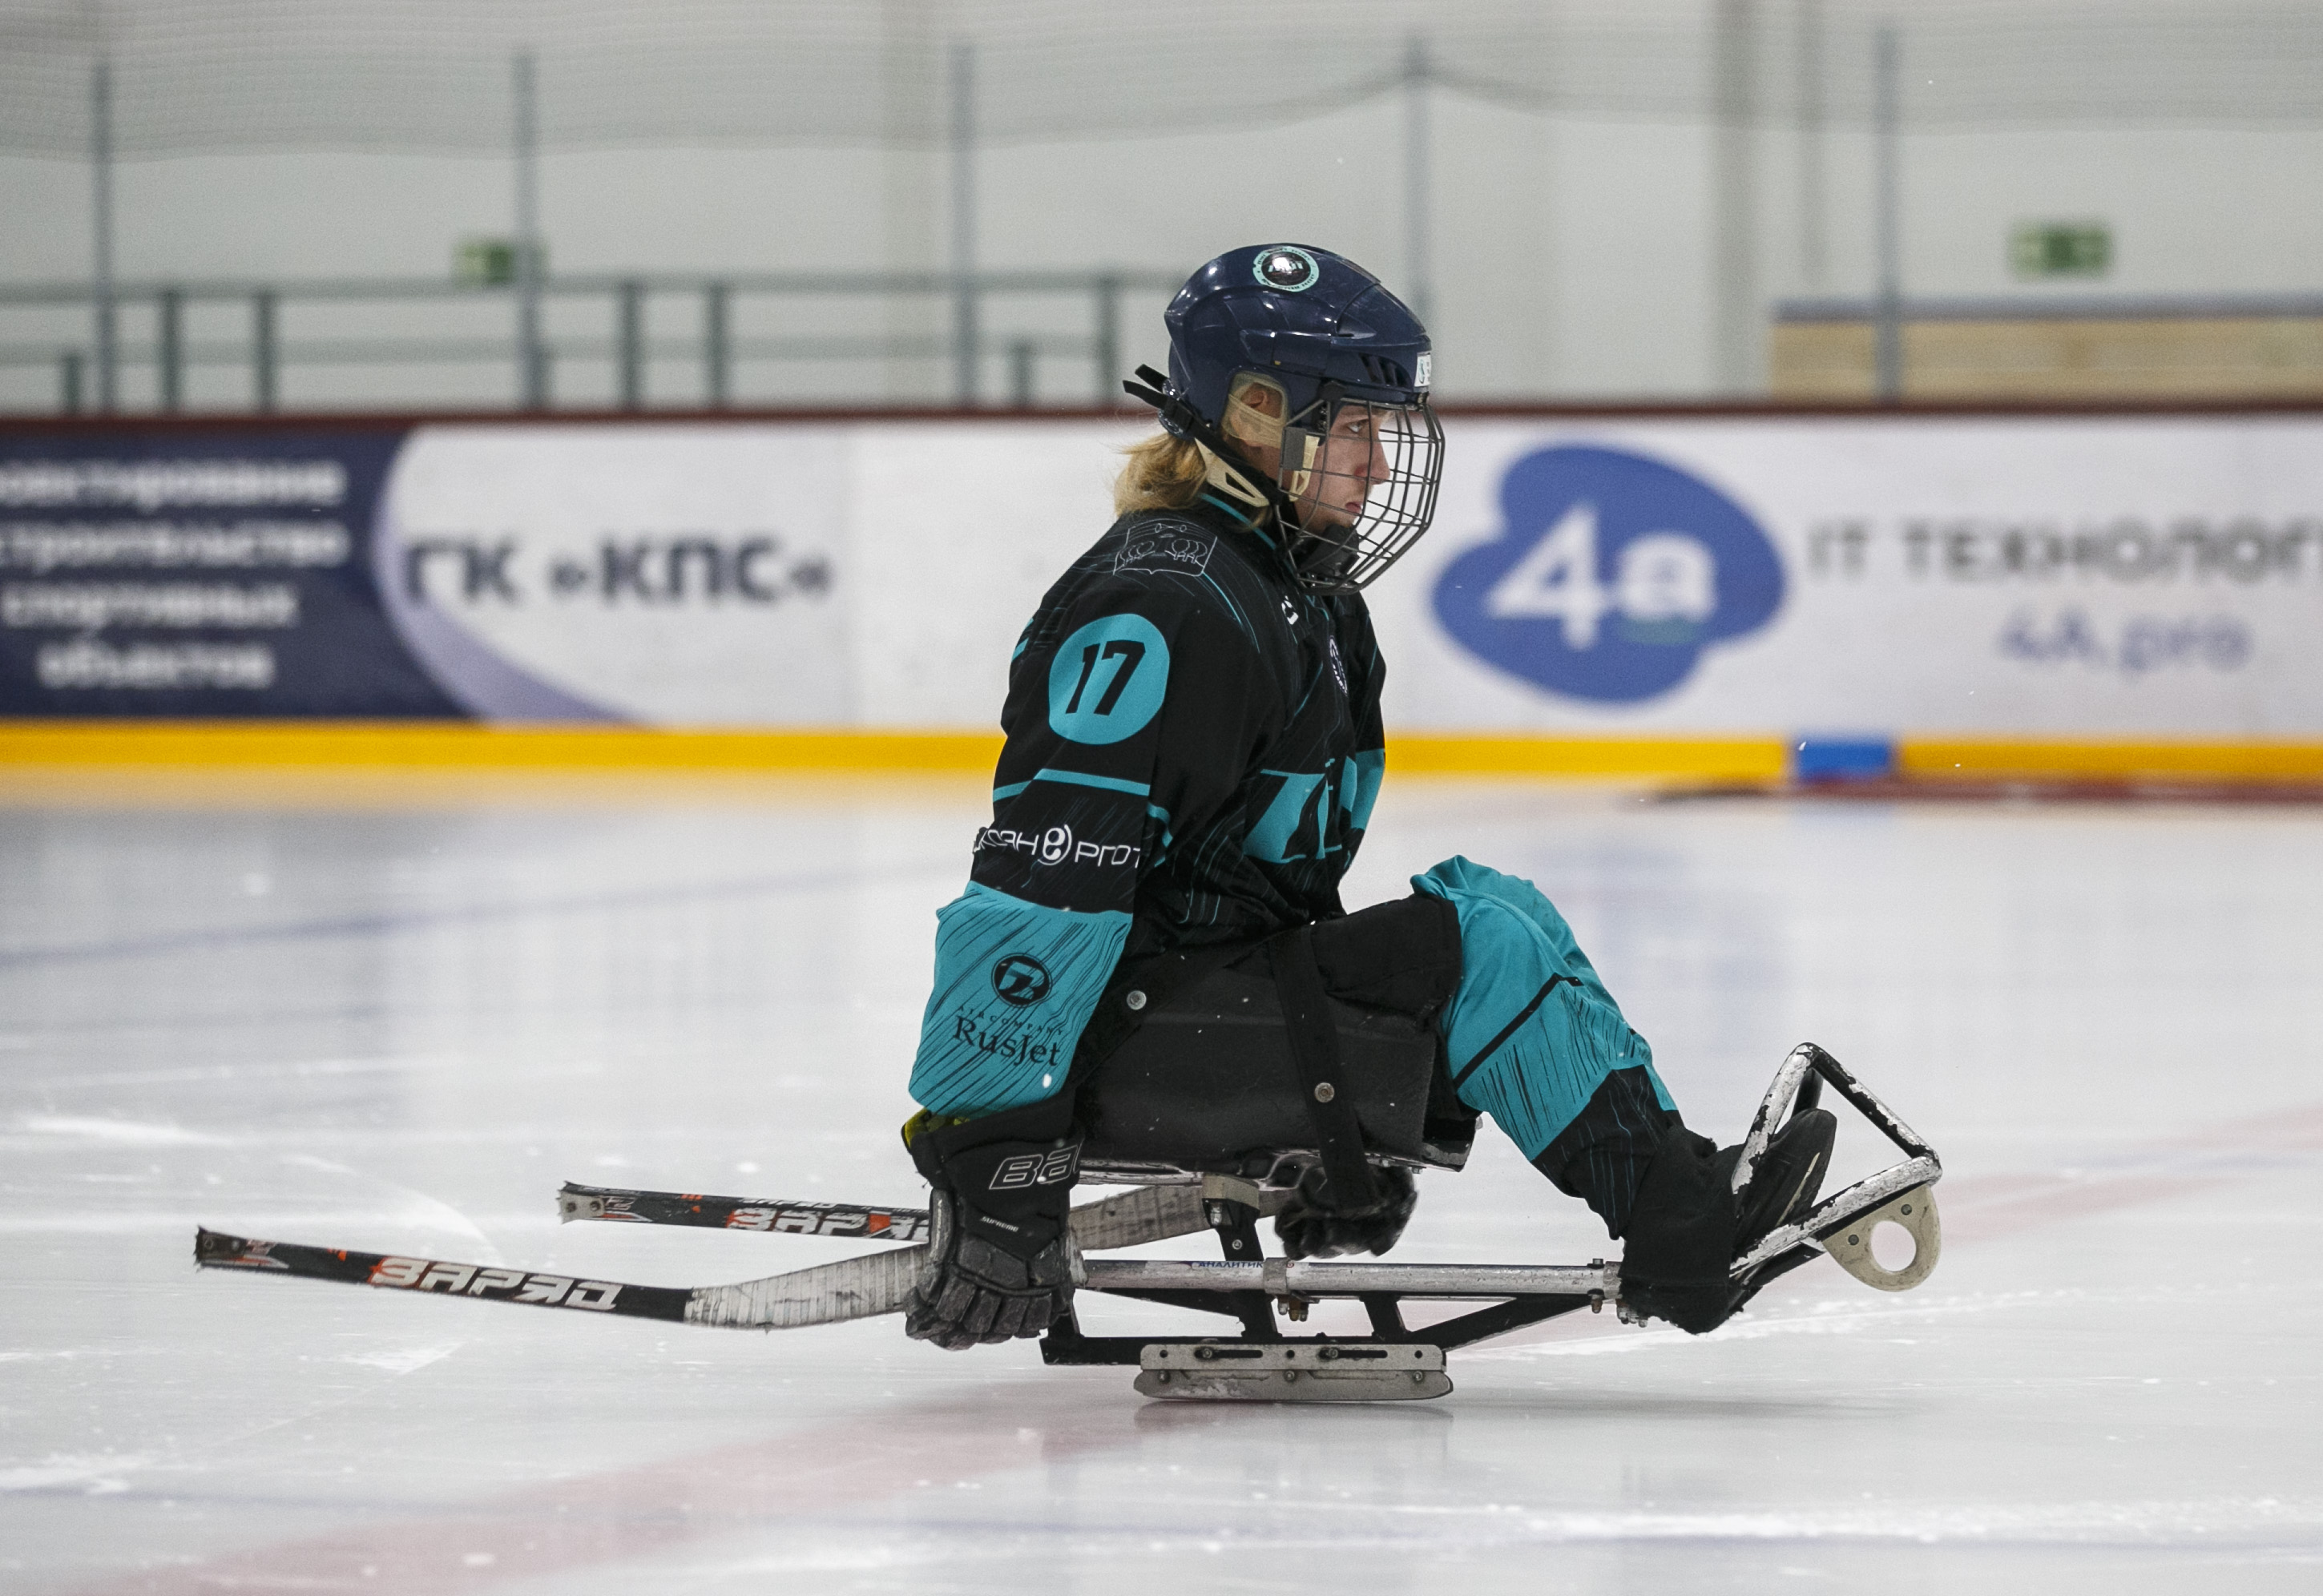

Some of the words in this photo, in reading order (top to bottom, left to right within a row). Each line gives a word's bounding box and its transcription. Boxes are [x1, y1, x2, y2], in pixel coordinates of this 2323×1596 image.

[0, 461, 345, 511] оектирование
[0, 523, 349, 571] троительство
[408, 537, 517, 601] ГК
[1900, 517, 2323, 583] ТЕХНОЛОГ
[1065, 639, 1146, 716] 17
[953, 1015, 1060, 1067] RusJet
